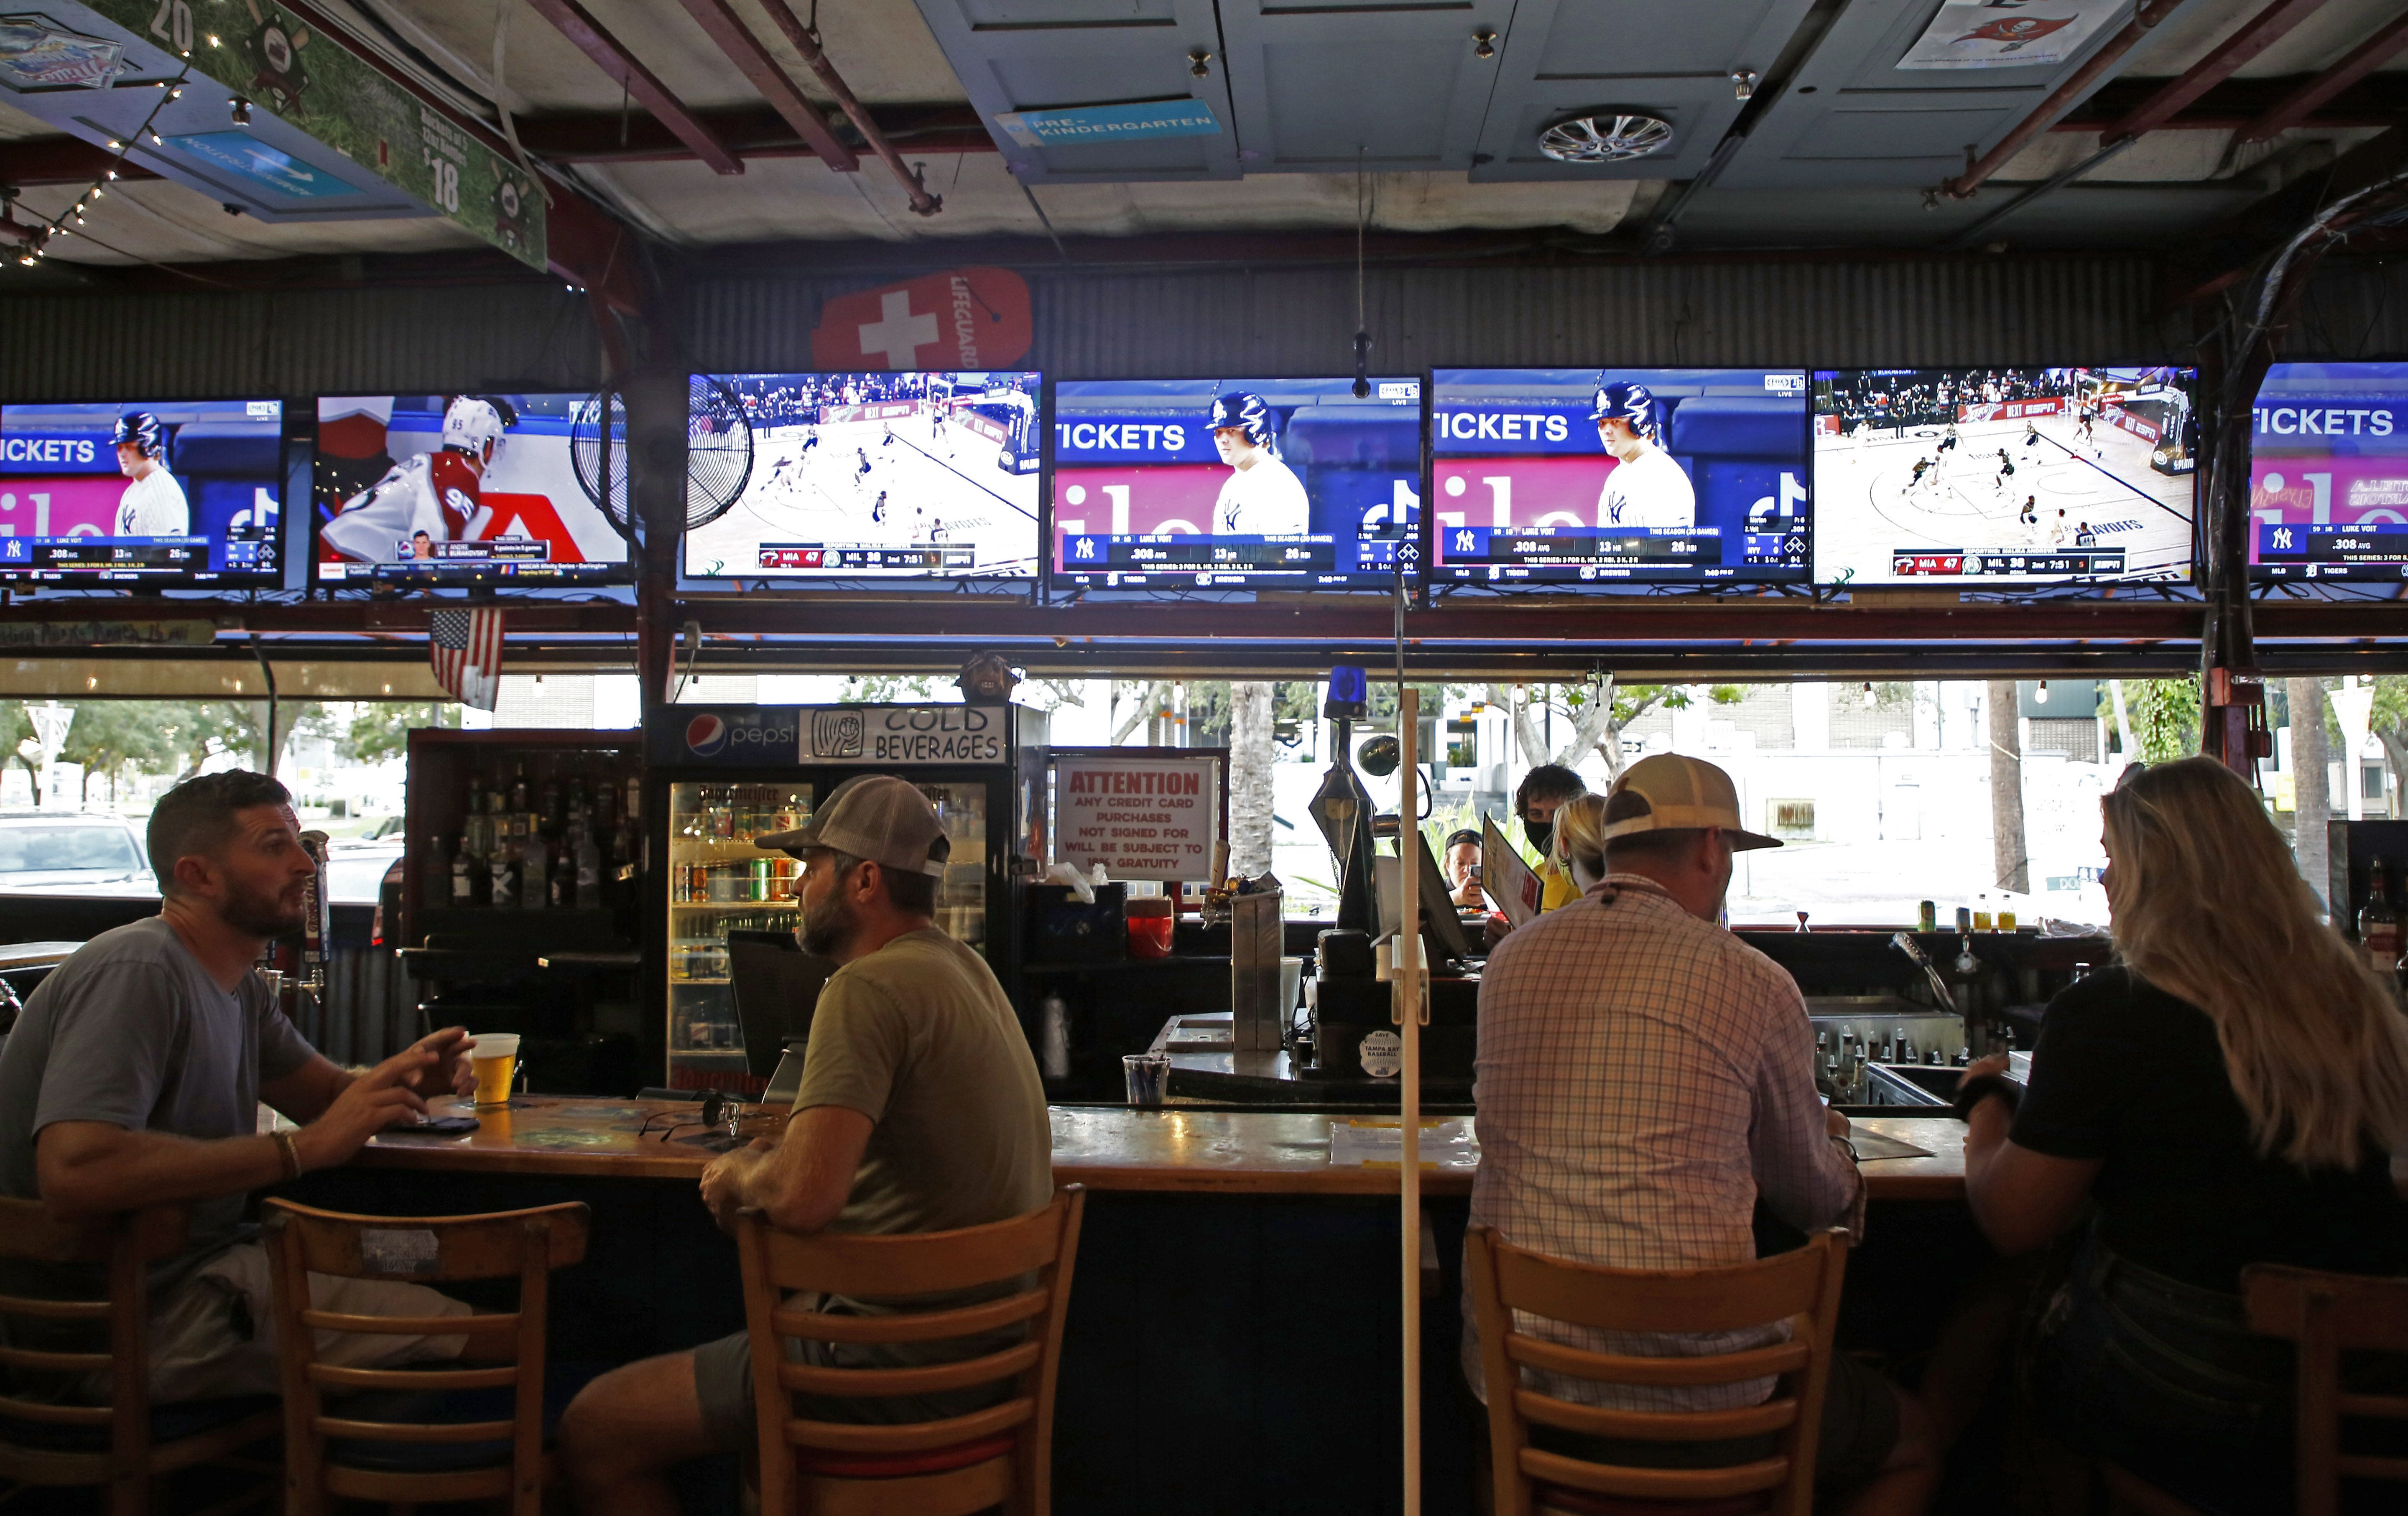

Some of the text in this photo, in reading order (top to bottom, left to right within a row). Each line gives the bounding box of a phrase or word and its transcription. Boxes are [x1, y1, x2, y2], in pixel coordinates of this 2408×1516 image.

[1040, 116, 1211, 137] KINDERGARTEN
[950, 275, 980, 369] LIFEGUARD
[2007, 403, 2055, 418] NEXT ESPN
[1773, 536, 1779, 544] 4
[2332, 539, 2357, 550] .308
[49, 549, 68, 558] .308
[114, 548, 124, 558] 13
[169, 548, 181, 558] 26
[1513, 541, 1537, 552] .308
[1599, 541, 1611, 552] 13
[1671, 541, 1685, 553] 26
[1773, 546, 1779, 554] 0
[783, 552, 800, 561] MIA
[805, 552, 819, 561] 47
[846, 552, 862, 561] MIL
[903, 555, 923, 564] 7:51
[1131, 548, 1154, 559] .308
[1215, 548, 1227, 559] 13
[1285, 548, 1299, 559] 26
[1918, 558, 1937, 568] MIA
[1944, 558, 1958, 568] 47
[1987, 558, 2005, 568] MIL
[2031, 561, 2046, 569] 2nd
[2049, 560, 2070, 570] 7:51
[2094, 560, 2121, 569] ESPN
[885, 708, 988, 732] COLD
[731, 725, 794, 747] pepsi
[876, 734, 998, 760] BEVERAGES
[1069, 771, 1199, 795] ATTENTION
[1074, 797, 1194, 808] ANY CREDIT CARD
[1096, 812, 1172, 823] PURCHASES
[1079, 827, 1189, 839] NOT SIGNED FOR
[1065, 841, 1202, 854] WILL BE SUBJECT TO
[1117, 857, 1179, 870] GRATUITY
